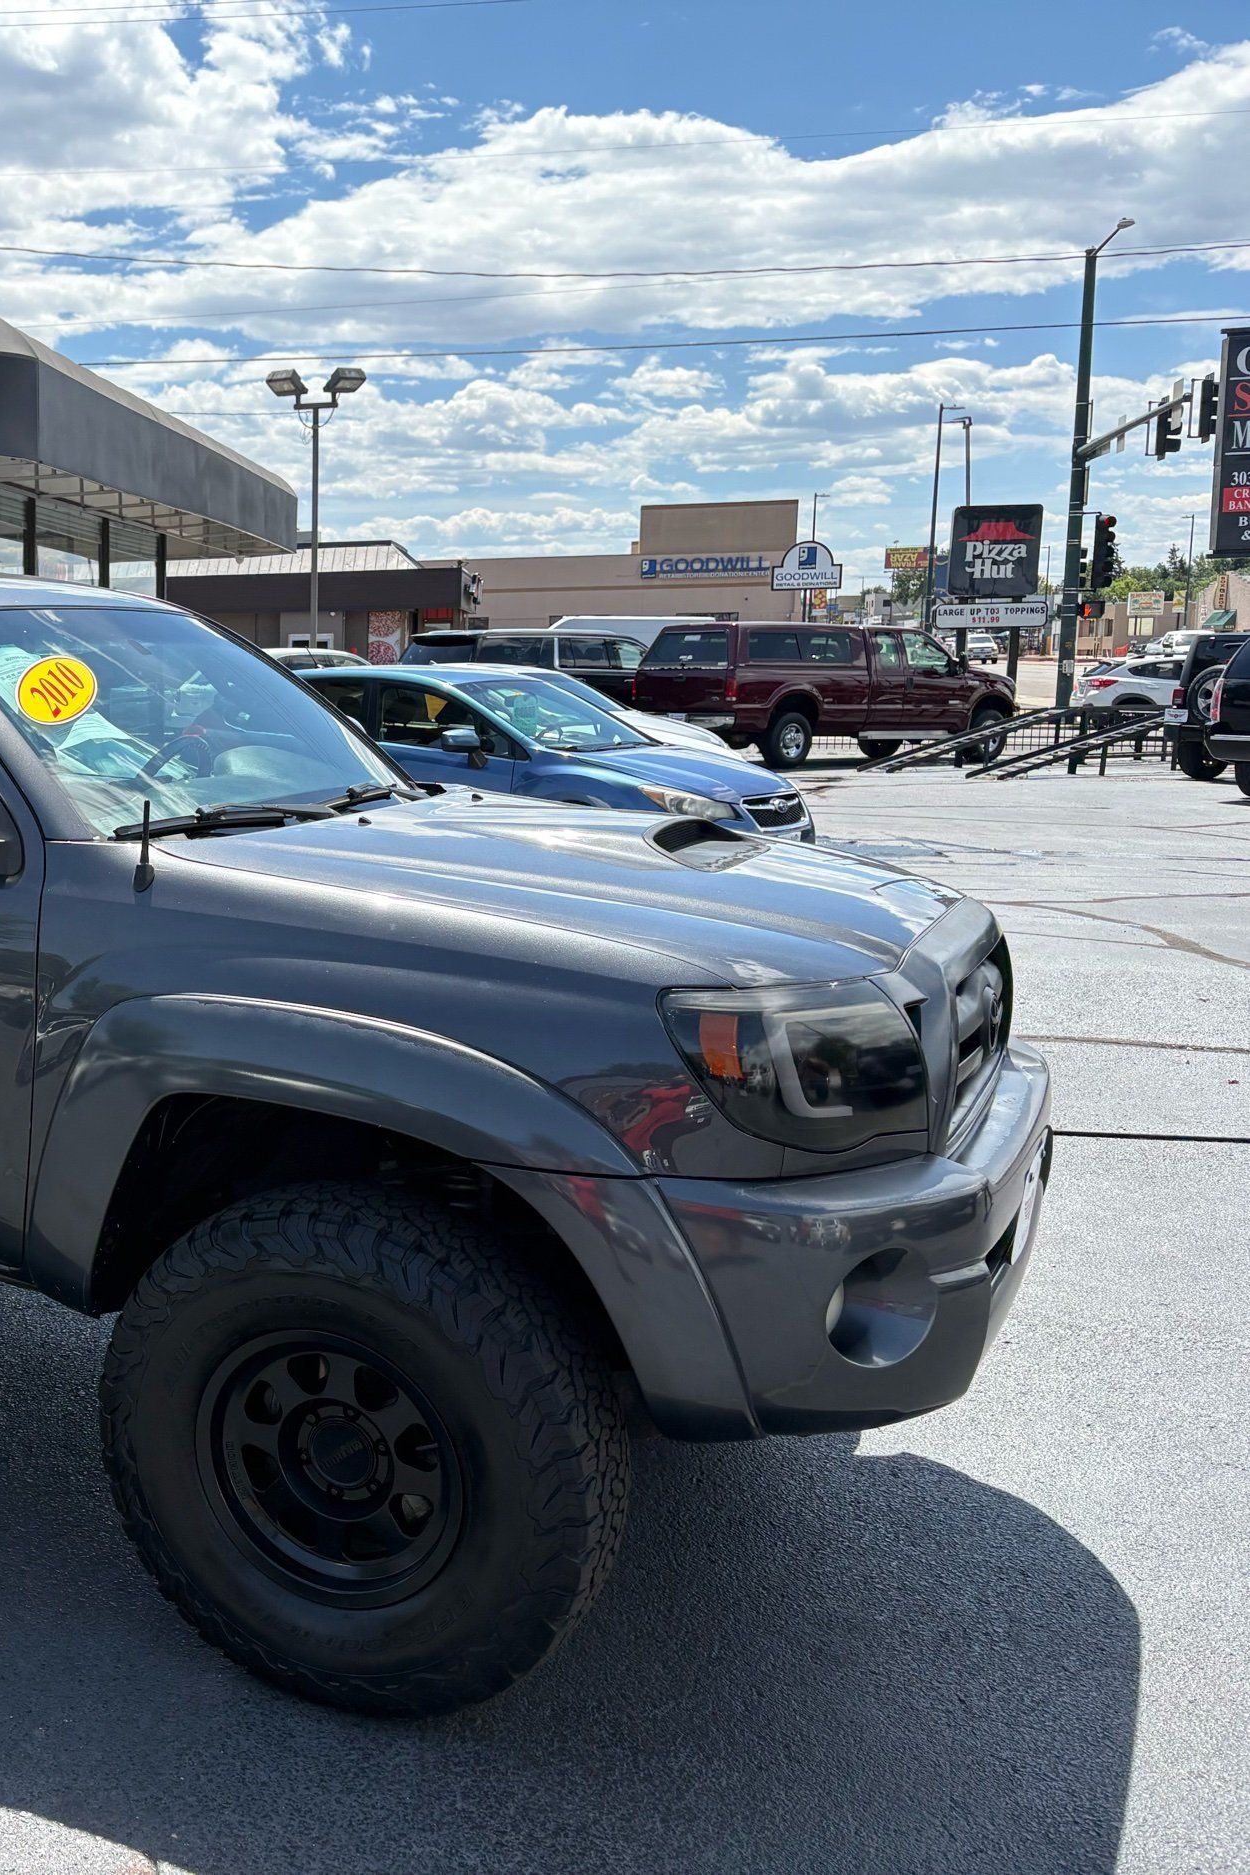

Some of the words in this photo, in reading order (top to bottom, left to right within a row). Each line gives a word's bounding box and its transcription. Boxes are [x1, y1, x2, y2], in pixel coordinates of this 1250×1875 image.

[965, 540, 1027, 561] Pizza
[659, 556, 770, 573] GOODWILL
[965, 559, 1015, 579] Hut
[775, 572, 838, 581] GOODWILL
[938, 608, 965, 617] LARGE
[970, 607, 982, 616] UP
[1004, 606, 1046, 615] TOPPINGS
[971, 616, 1000, 624] $11.99
[30, 662, 84, 718] 2010
